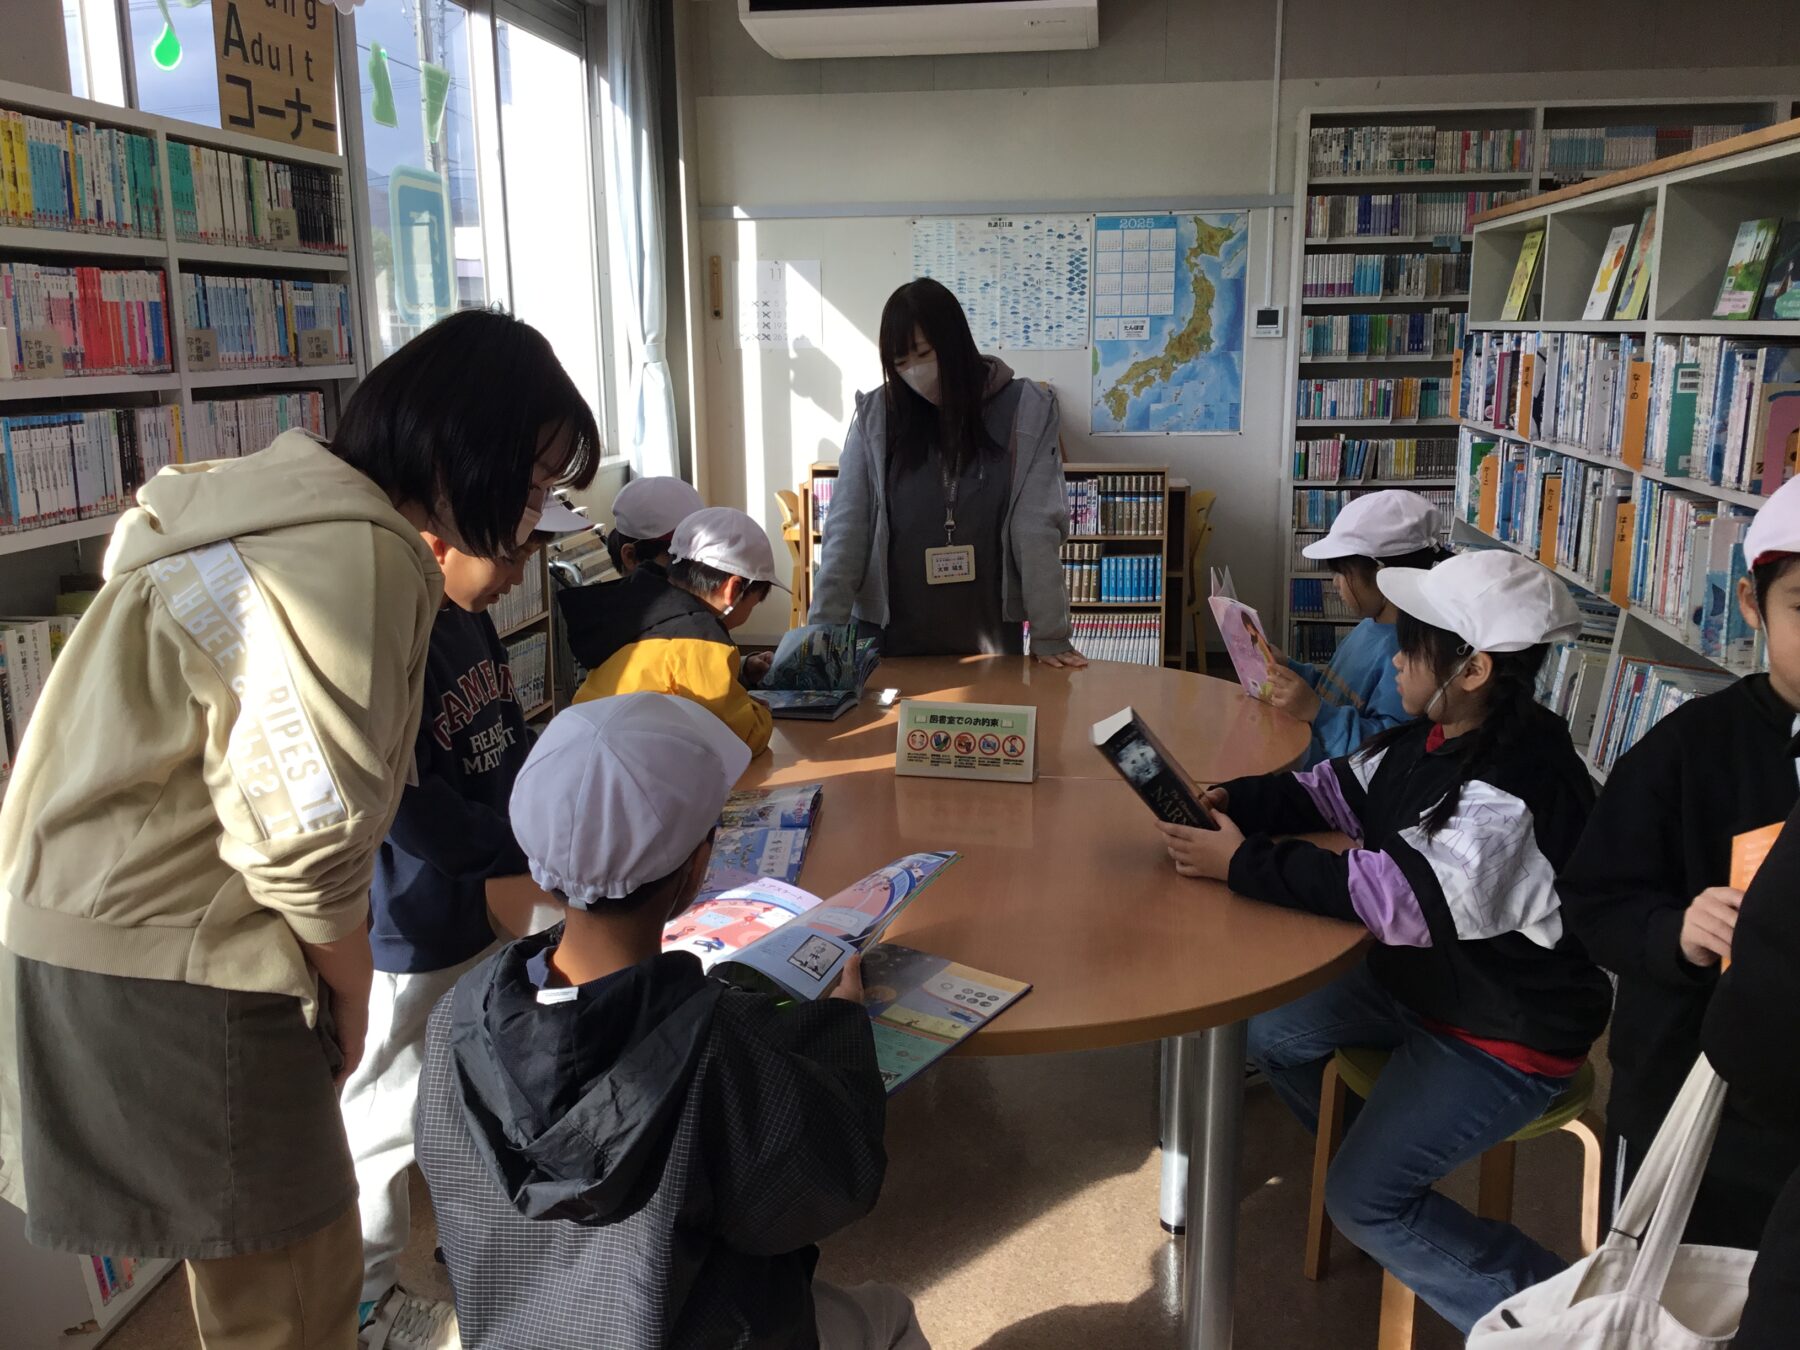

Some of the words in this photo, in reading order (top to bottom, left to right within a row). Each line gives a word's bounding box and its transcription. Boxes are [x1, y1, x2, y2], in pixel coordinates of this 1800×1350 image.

[223, 2, 315, 82] Adult
[225, 73, 337, 140] コーナー
[1119, 217, 1155, 229] 2025
[929, 714, 1000, 728] 図書室でのお約束
